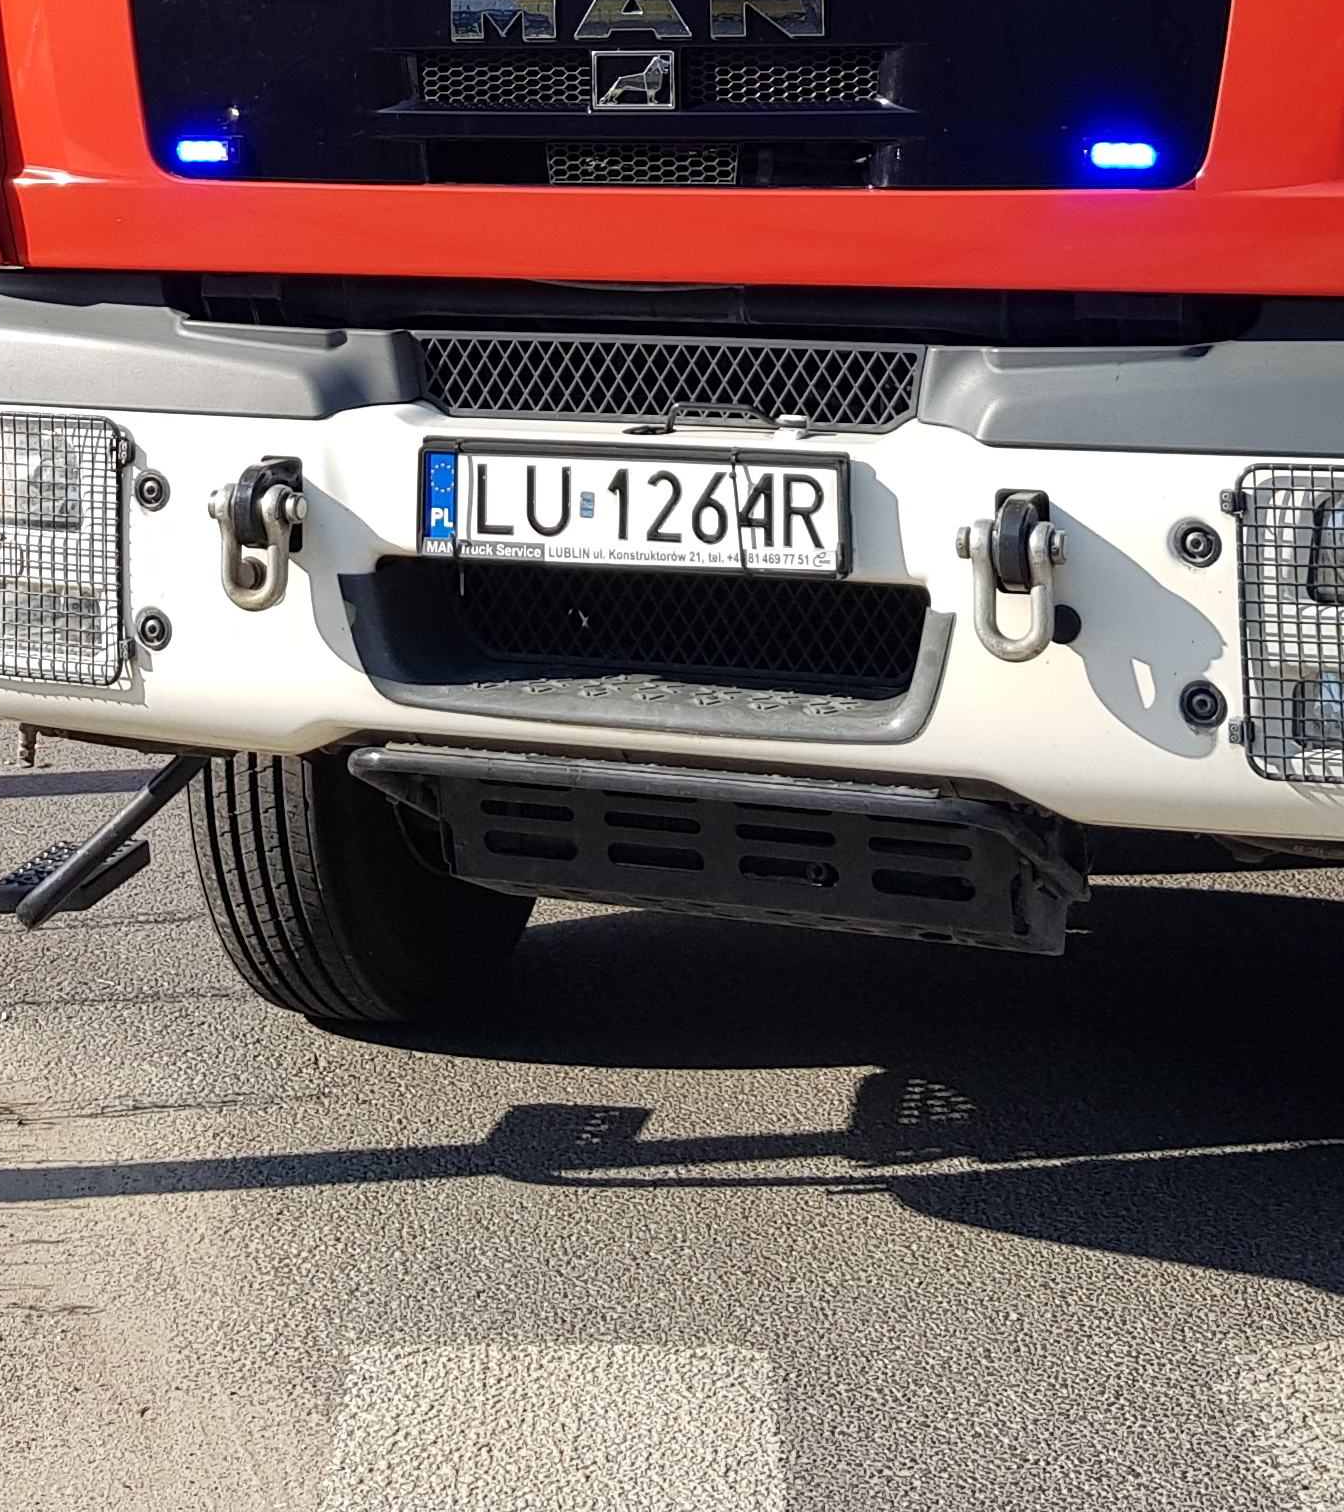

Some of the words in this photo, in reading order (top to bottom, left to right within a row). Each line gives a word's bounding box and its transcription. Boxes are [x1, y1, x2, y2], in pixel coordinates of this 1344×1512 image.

[430, 507, 453, 528] PL
[477, 463, 572, 537] LU
[607, 467, 825, 550] 1264R
[426, 541, 454, 554] MAN
[460, 542, 493, 556] Truck
[495, 544, 542, 558] Service
[548, 546, 590, 560] LUBLIN
[594, 548, 605, 560] ul.
[608, 548, 686, 563] Konstruktorów
[689, 551, 705, 564] 21,
[708, 551, 725, 563] tel.
[762, 553, 781, 565] 469
[783, 553, 795, 565] 77
[797, 554, 809, 566] 51
